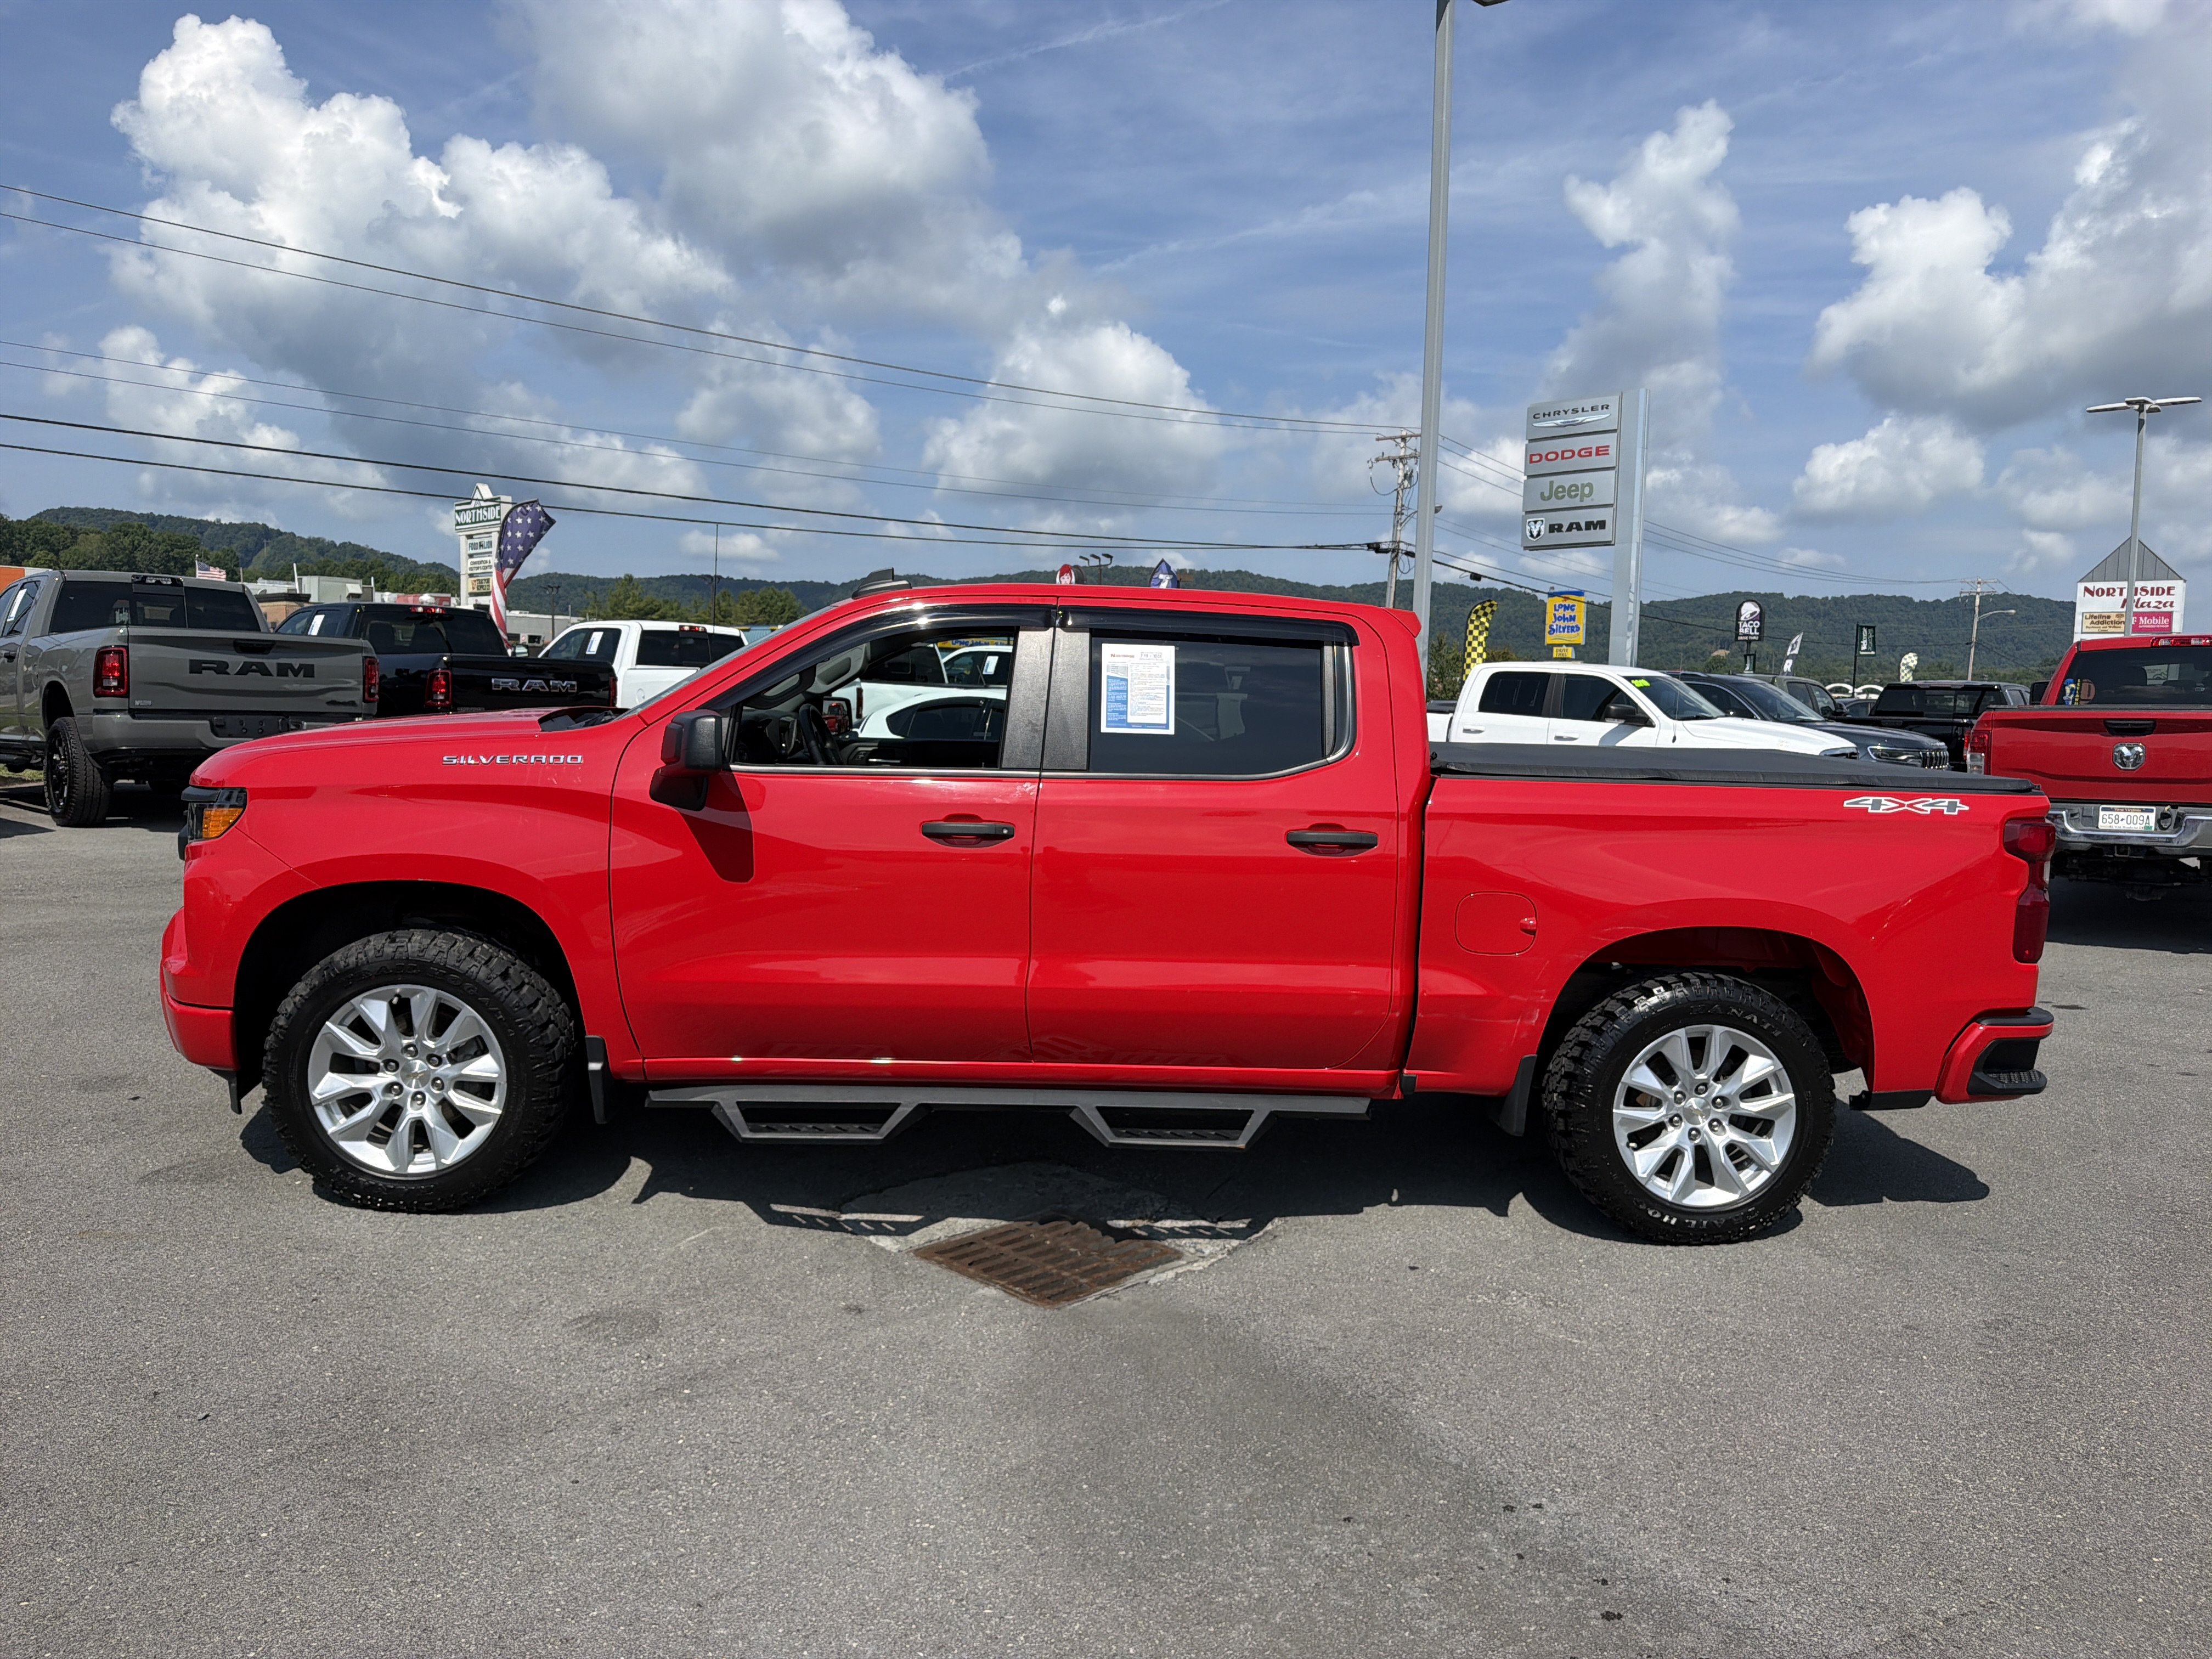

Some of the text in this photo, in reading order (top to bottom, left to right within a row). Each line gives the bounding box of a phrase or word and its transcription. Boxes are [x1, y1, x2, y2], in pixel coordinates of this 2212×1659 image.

[1533, 404, 1610, 419] CHRYSLER
[1528, 445, 1610, 464] DODGE
[1540, 480, 1594, 502] Jeep
[455, 507, 500, 524] NORTHSIDE
[1548, 520, 1606, 534] RAM
[2083, 585, 2176, 597] NORTSIDE
[1554, 603, 1576, 612] LONG
[2139, 616, 2169, 624] Mobile
[189, 659, 315, 678] RAM
[492, 678, 577, 692] RAM
[442, 755, 583, 765] SILVERADO
